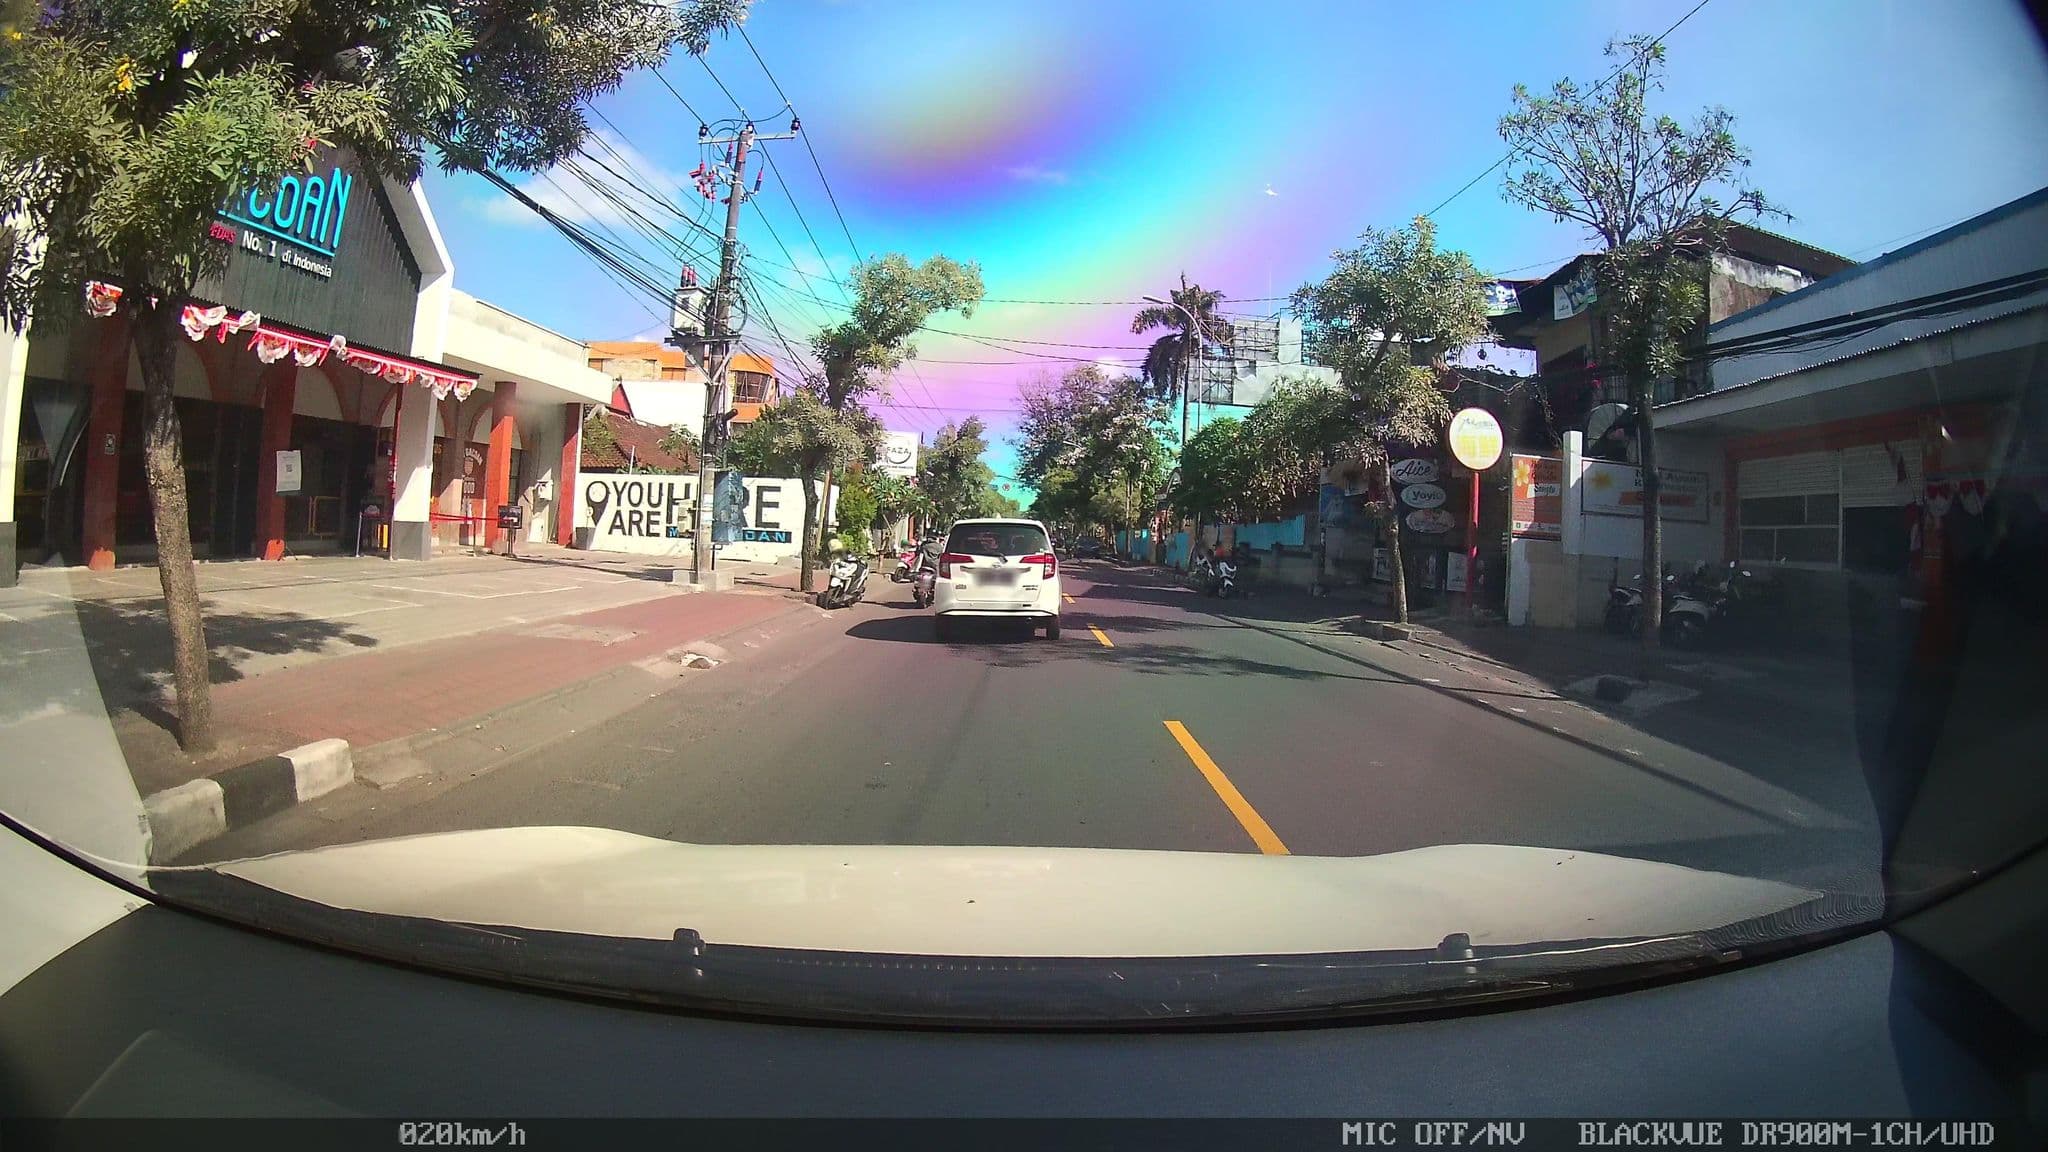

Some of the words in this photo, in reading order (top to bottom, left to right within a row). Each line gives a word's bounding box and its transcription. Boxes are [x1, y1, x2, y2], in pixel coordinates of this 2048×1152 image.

[241, 230, 263, 252] No.
[269, 240, 277, 257] 1
[293, 253, 332, 278] Indonesia
[1395, 461, 1432, 477] Aice
[612, 481, 664, 508] YOU
[608, 509, 661, 537] ARE
